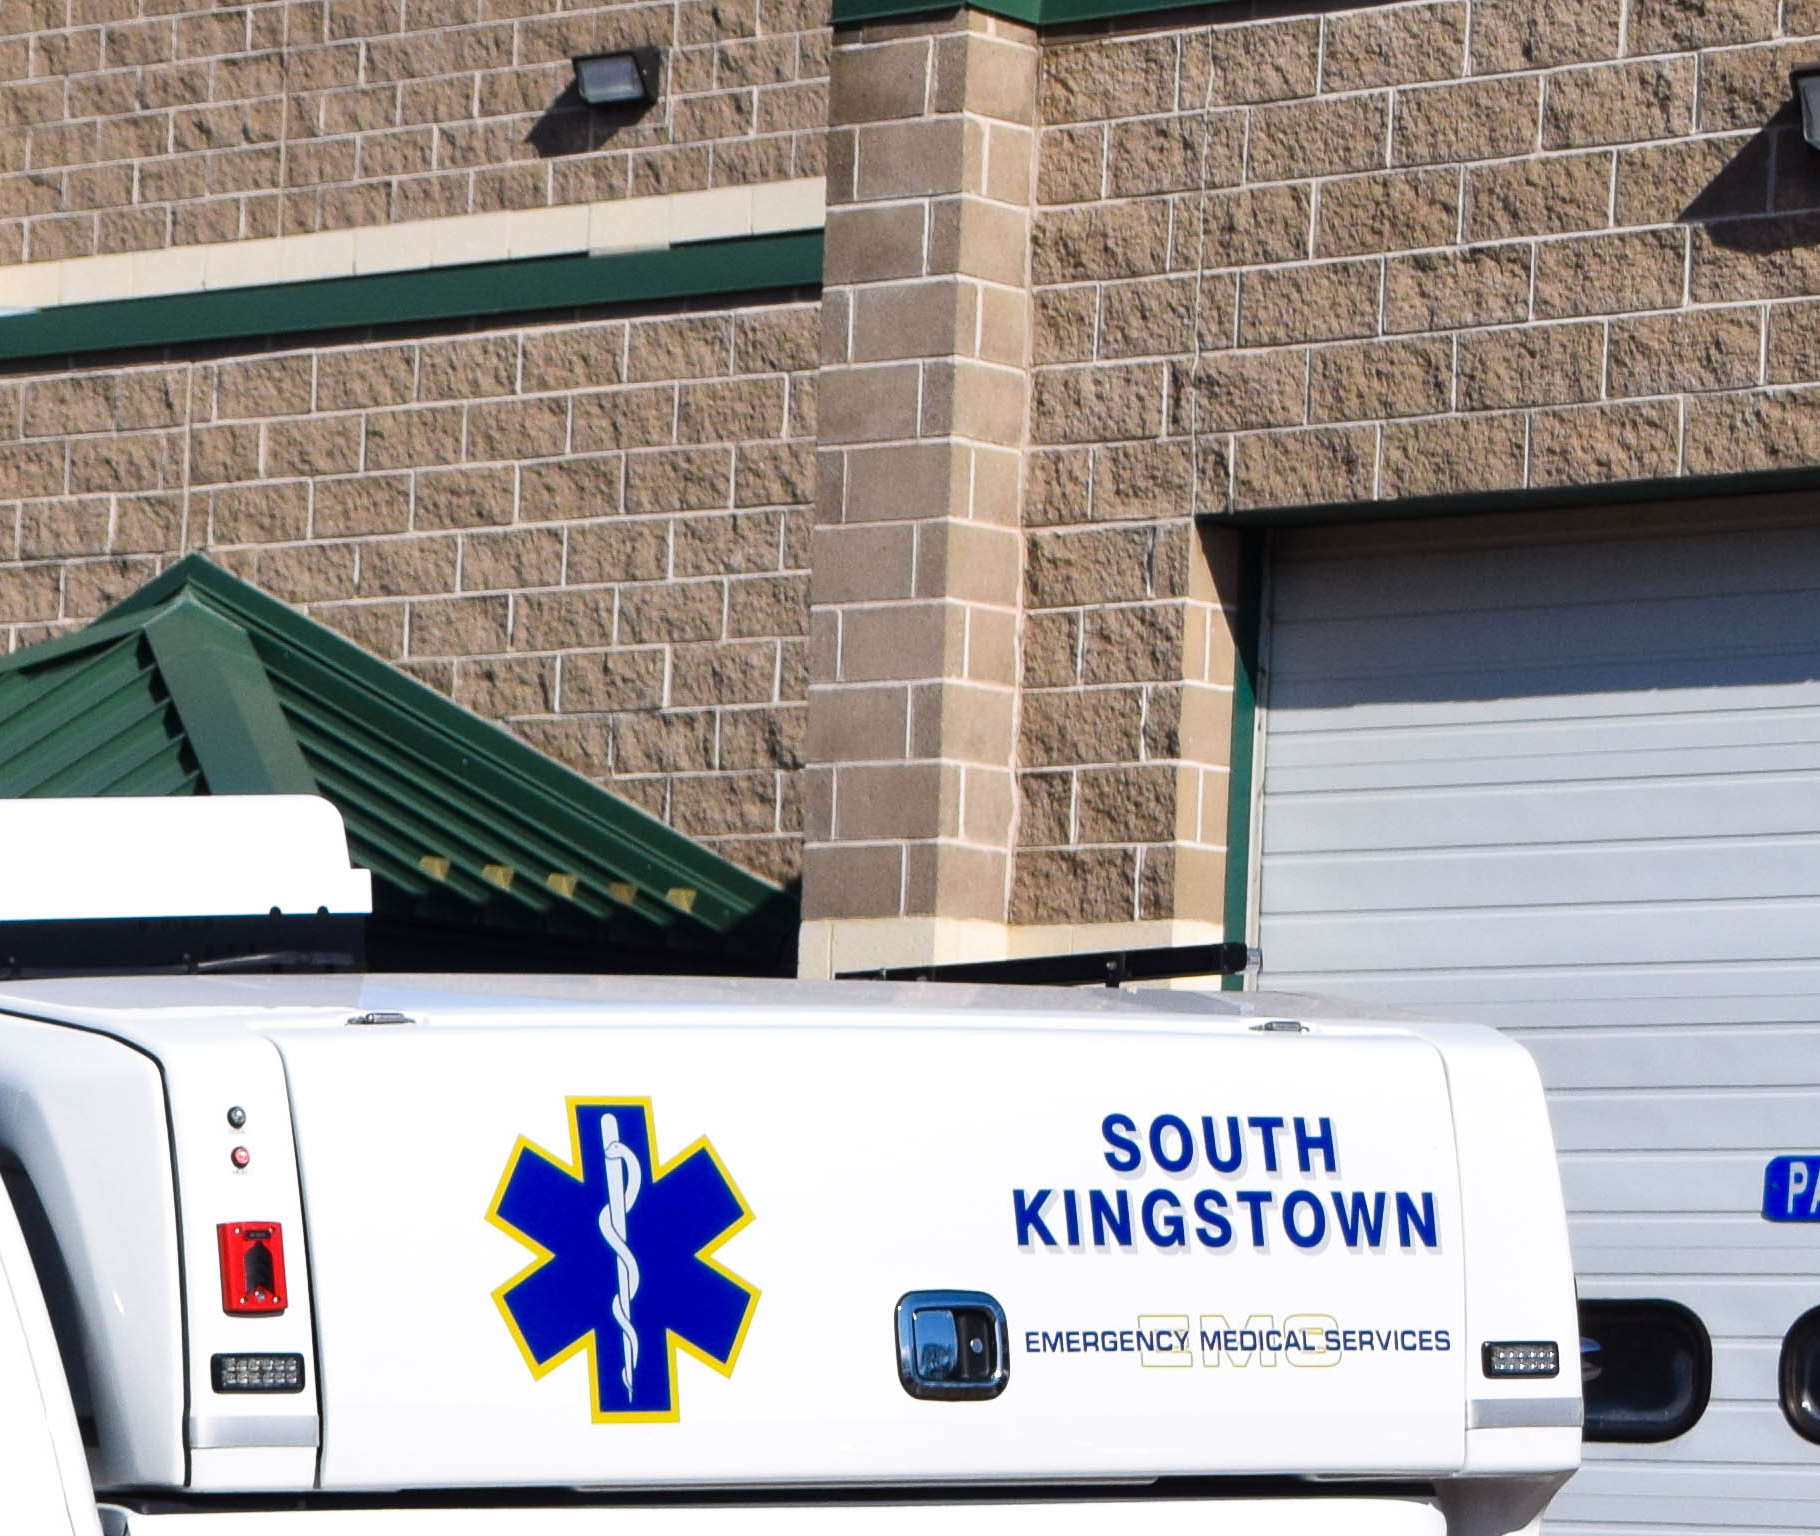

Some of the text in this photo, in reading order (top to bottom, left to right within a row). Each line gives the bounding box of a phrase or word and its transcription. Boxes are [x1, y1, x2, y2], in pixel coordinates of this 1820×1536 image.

[1101, 1113, 1337, 1175] SOUTH
[1013, 1187, 1440, 1251] KINGSTOWN
[1024, 1328, 1452, 1354] EMERGENCY MEDICAL SERVICES
